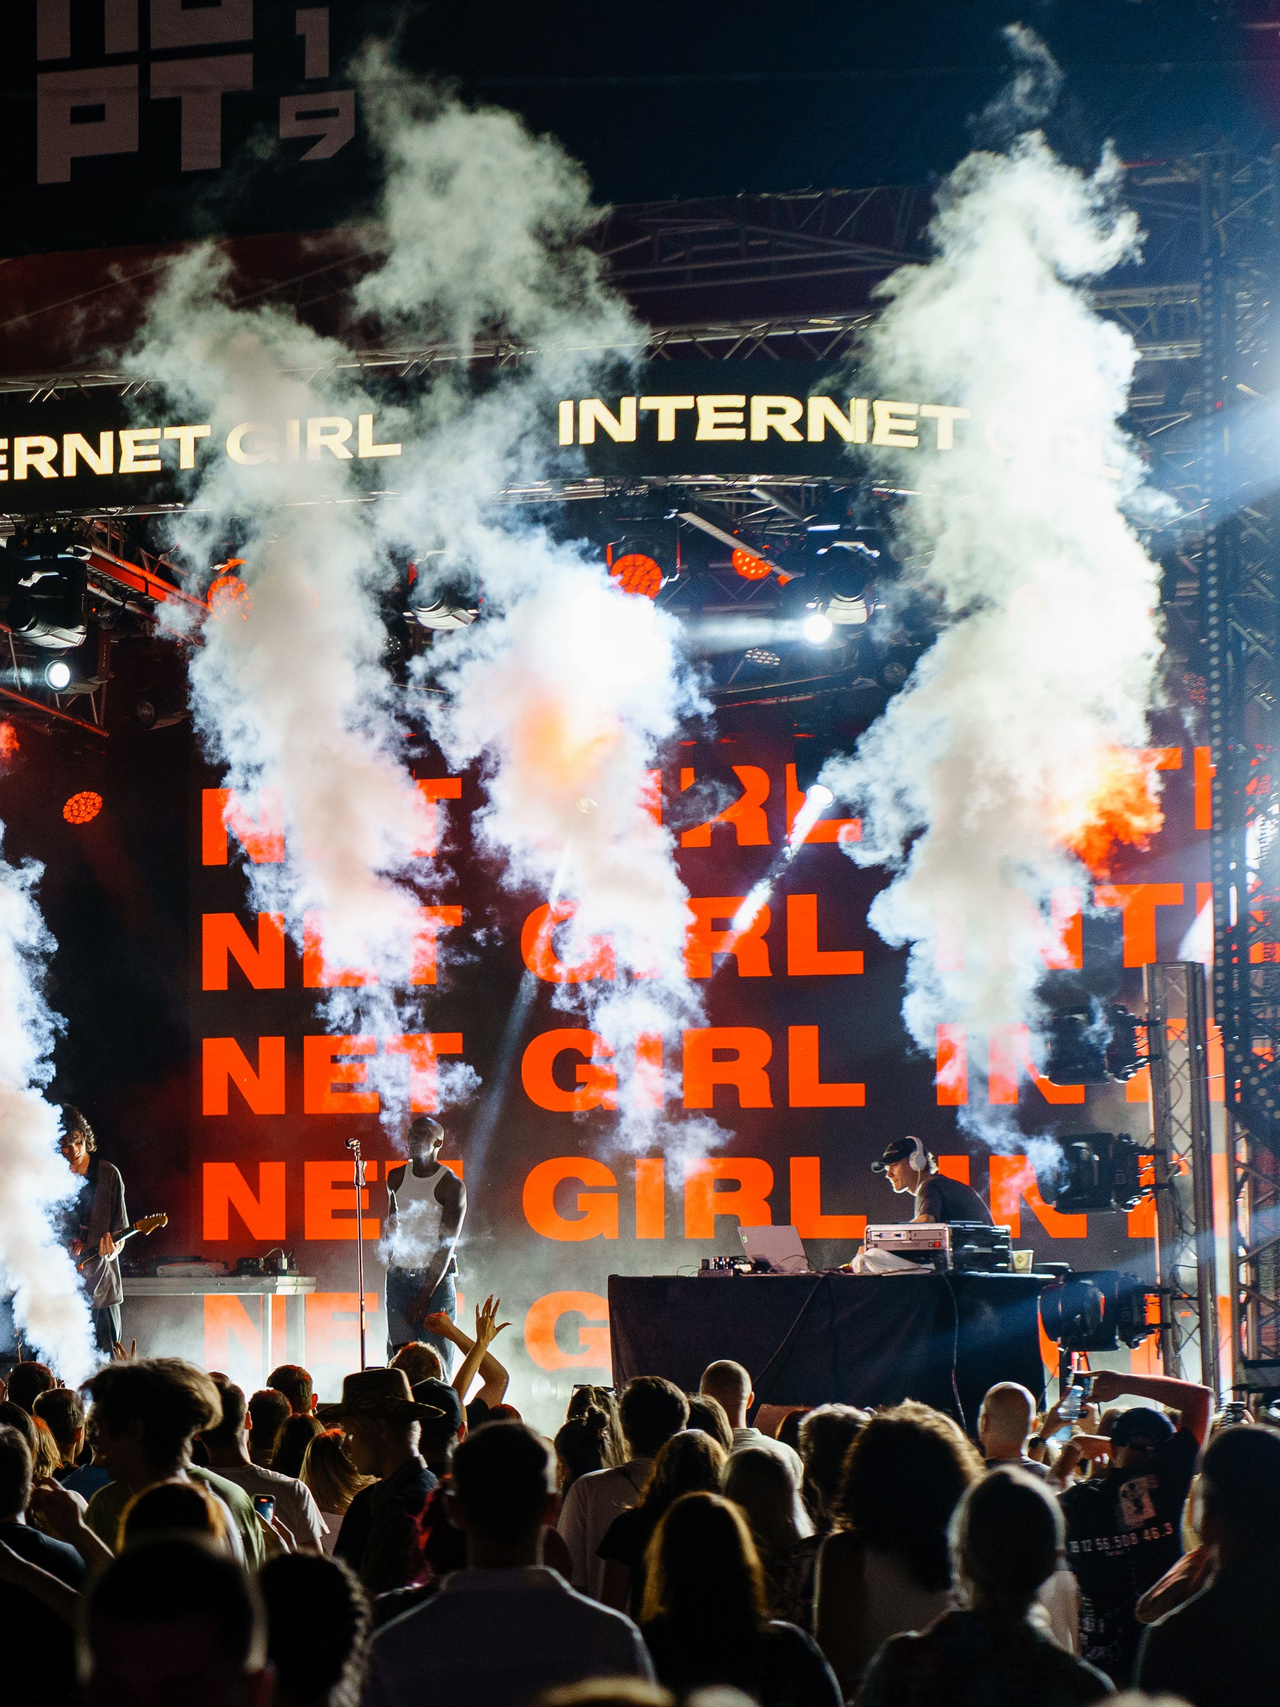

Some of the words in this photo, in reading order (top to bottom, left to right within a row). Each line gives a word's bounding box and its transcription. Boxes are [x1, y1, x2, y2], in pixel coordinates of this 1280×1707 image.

[225, 413, 402, 466] GIRL
[558, 395, 970, 452] INTERNET
[202, 777, 463, 866] NT
[202, 1032, 464, 1116] NET
[521, 1025, 866, 1109] GIRL
[202, 1159, 464, 1241] NE
[523, 1156, 867, 1242] GIRL
